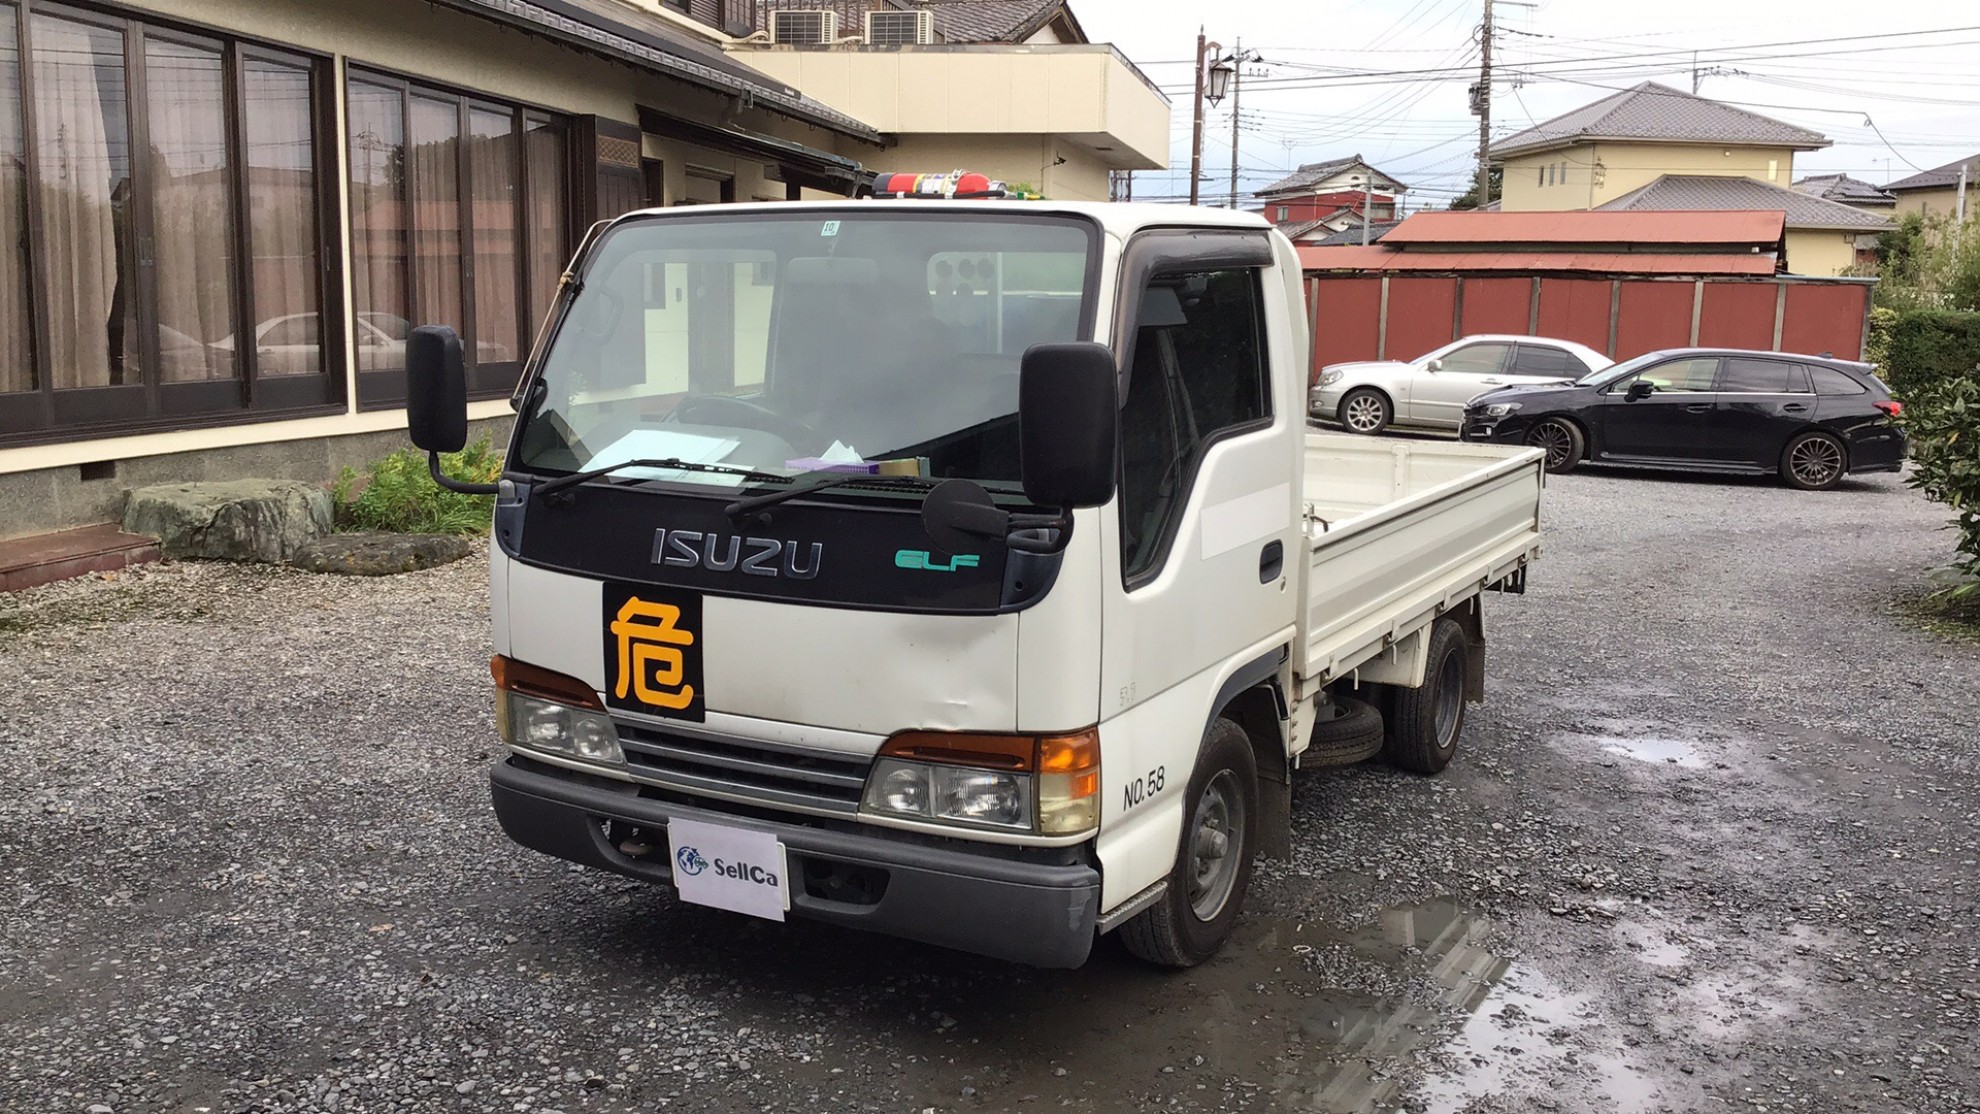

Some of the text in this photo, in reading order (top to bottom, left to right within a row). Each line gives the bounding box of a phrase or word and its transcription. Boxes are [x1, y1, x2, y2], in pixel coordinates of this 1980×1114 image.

[651, 528, 823, 580] ISUZU
[894, 549, 980, 572] ELF
[610, 595, 694, 710] 危
[1123, 765, 1165, 812] NO. 58
[714, 858, 779, 887] SellCa
